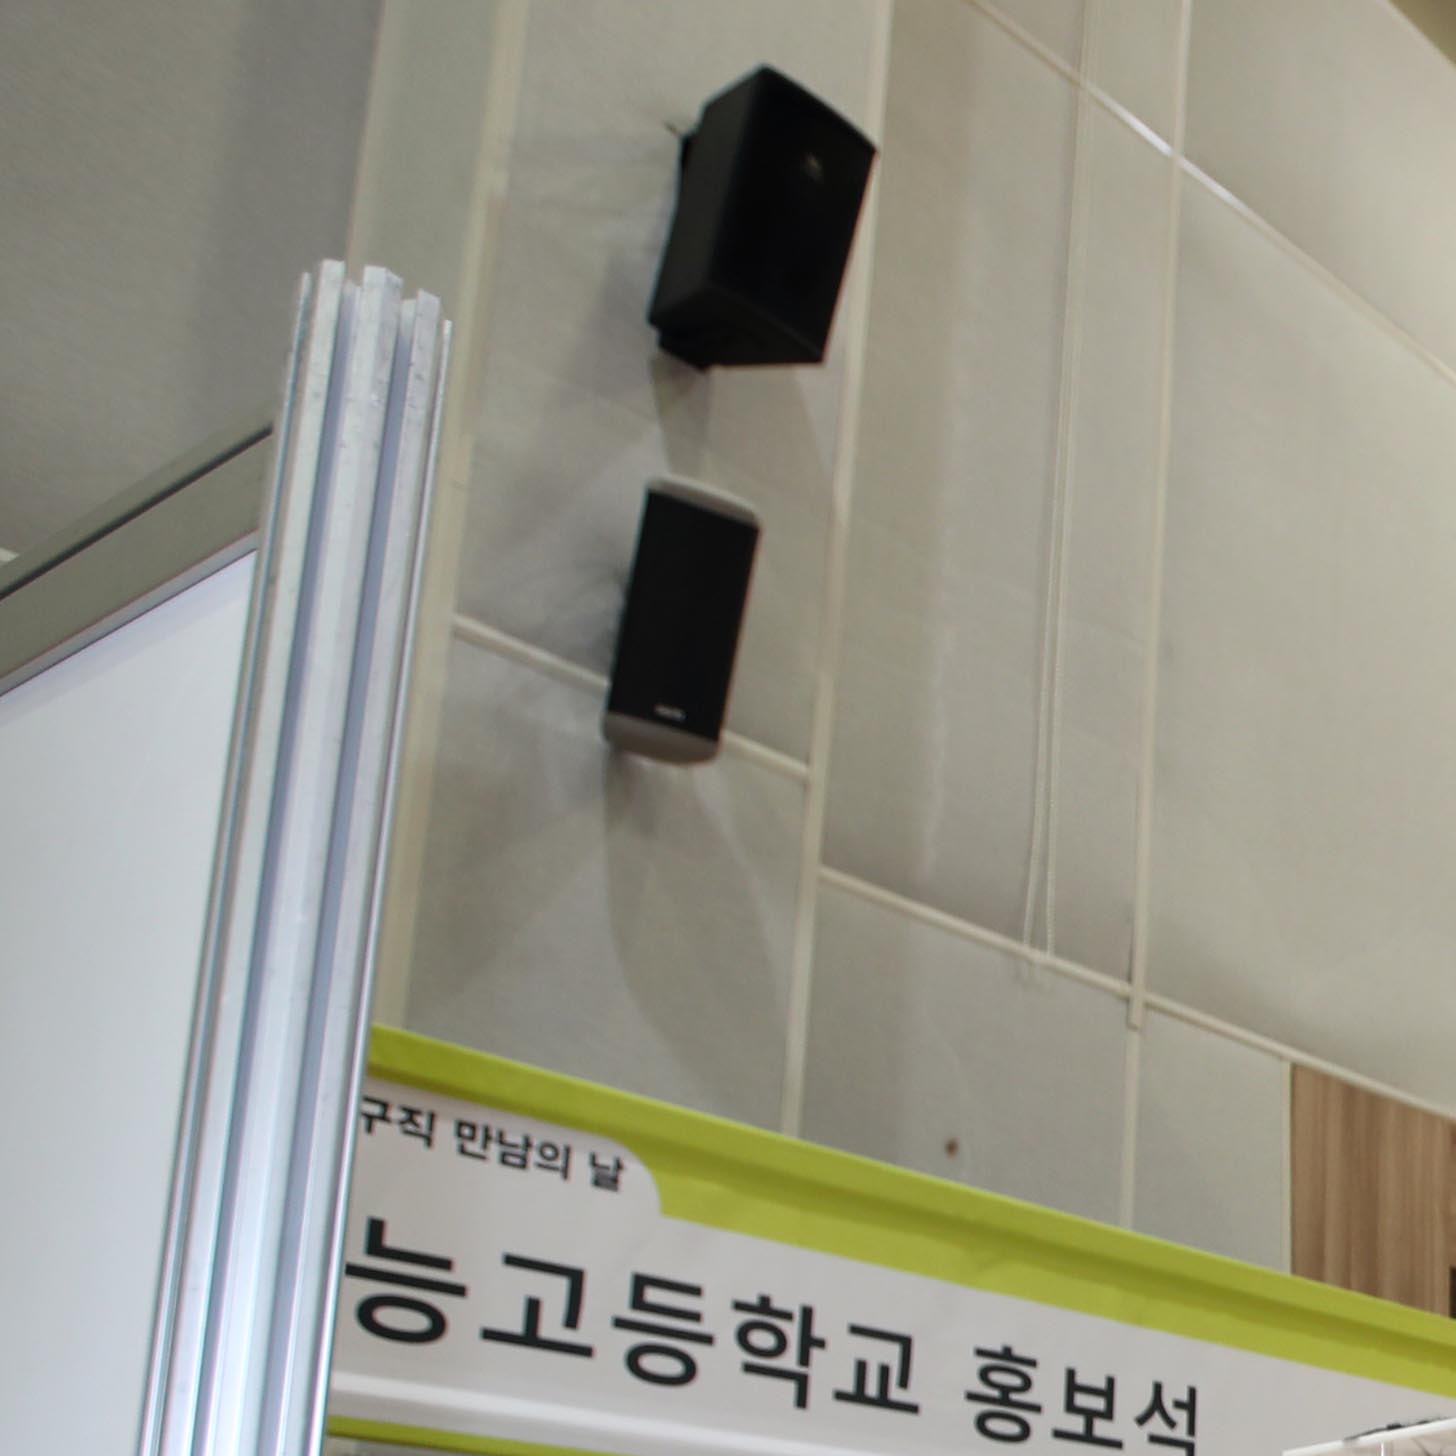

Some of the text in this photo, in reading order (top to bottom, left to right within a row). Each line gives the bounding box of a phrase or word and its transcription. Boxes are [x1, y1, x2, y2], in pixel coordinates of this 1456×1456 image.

[360, 1096, 624, 1192] 구직 만남의 날
[345, 1216, 920, 1415] 능고등학교
